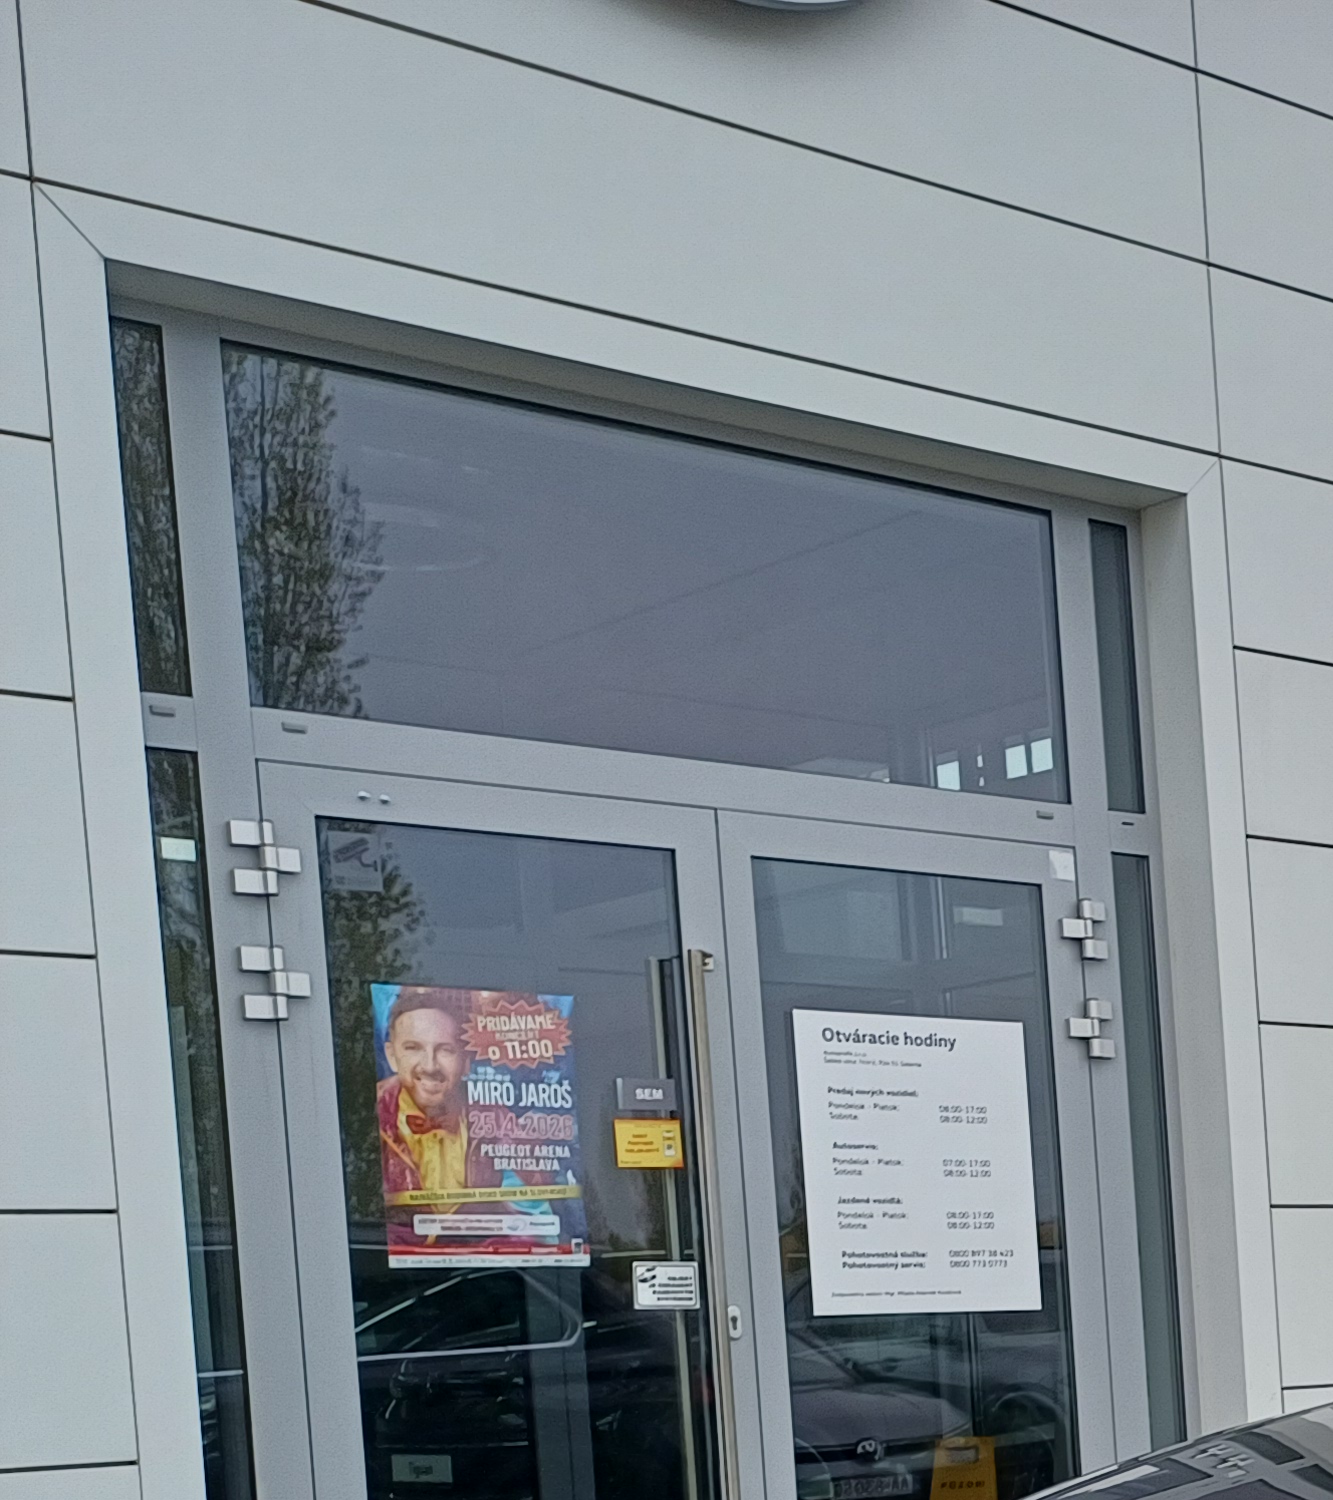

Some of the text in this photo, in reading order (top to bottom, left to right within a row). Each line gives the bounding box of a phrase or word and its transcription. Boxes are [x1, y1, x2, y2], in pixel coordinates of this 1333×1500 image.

[477, 1012, 556, 1032] PRIDÁVAME
[504, 1039, 553, 1059] 11:00
[821, 1027, 957, 1052] Otváracie hodiny
[467, 1079, 573, 1109] MIRO JAROŠ
[468, 1110, 575, 1140] 25.4.2026
[480, 1143, 531, 1157] PEUGEOT
[494, 1158, 560, 1171] BRATISLAVA
